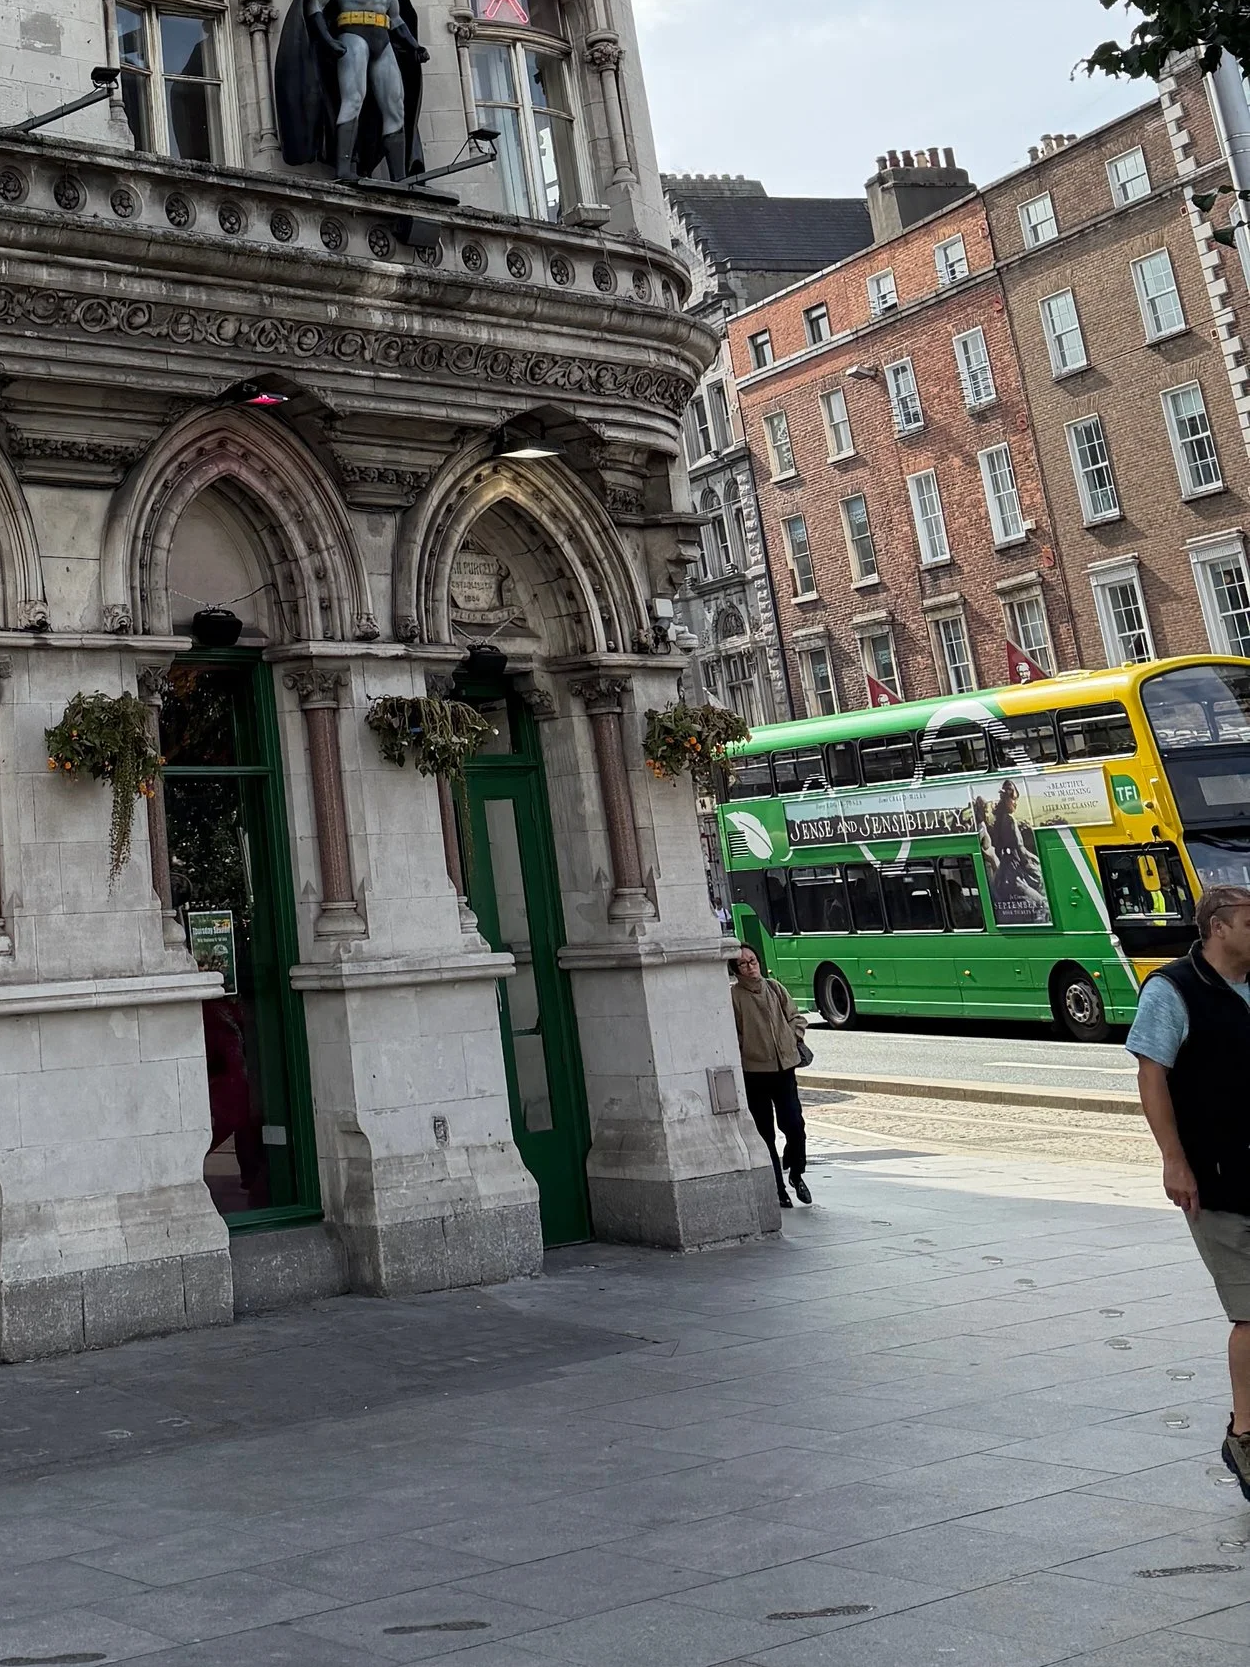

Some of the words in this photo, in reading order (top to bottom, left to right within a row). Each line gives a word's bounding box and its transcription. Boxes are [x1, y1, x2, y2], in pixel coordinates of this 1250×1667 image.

[1115, 785, 1138, 802] TFI
[790, 820, 834, 842] SENSE
[836, 820, 858, 835] AND
[859, 808, 964, 837] SENSIBILITY
